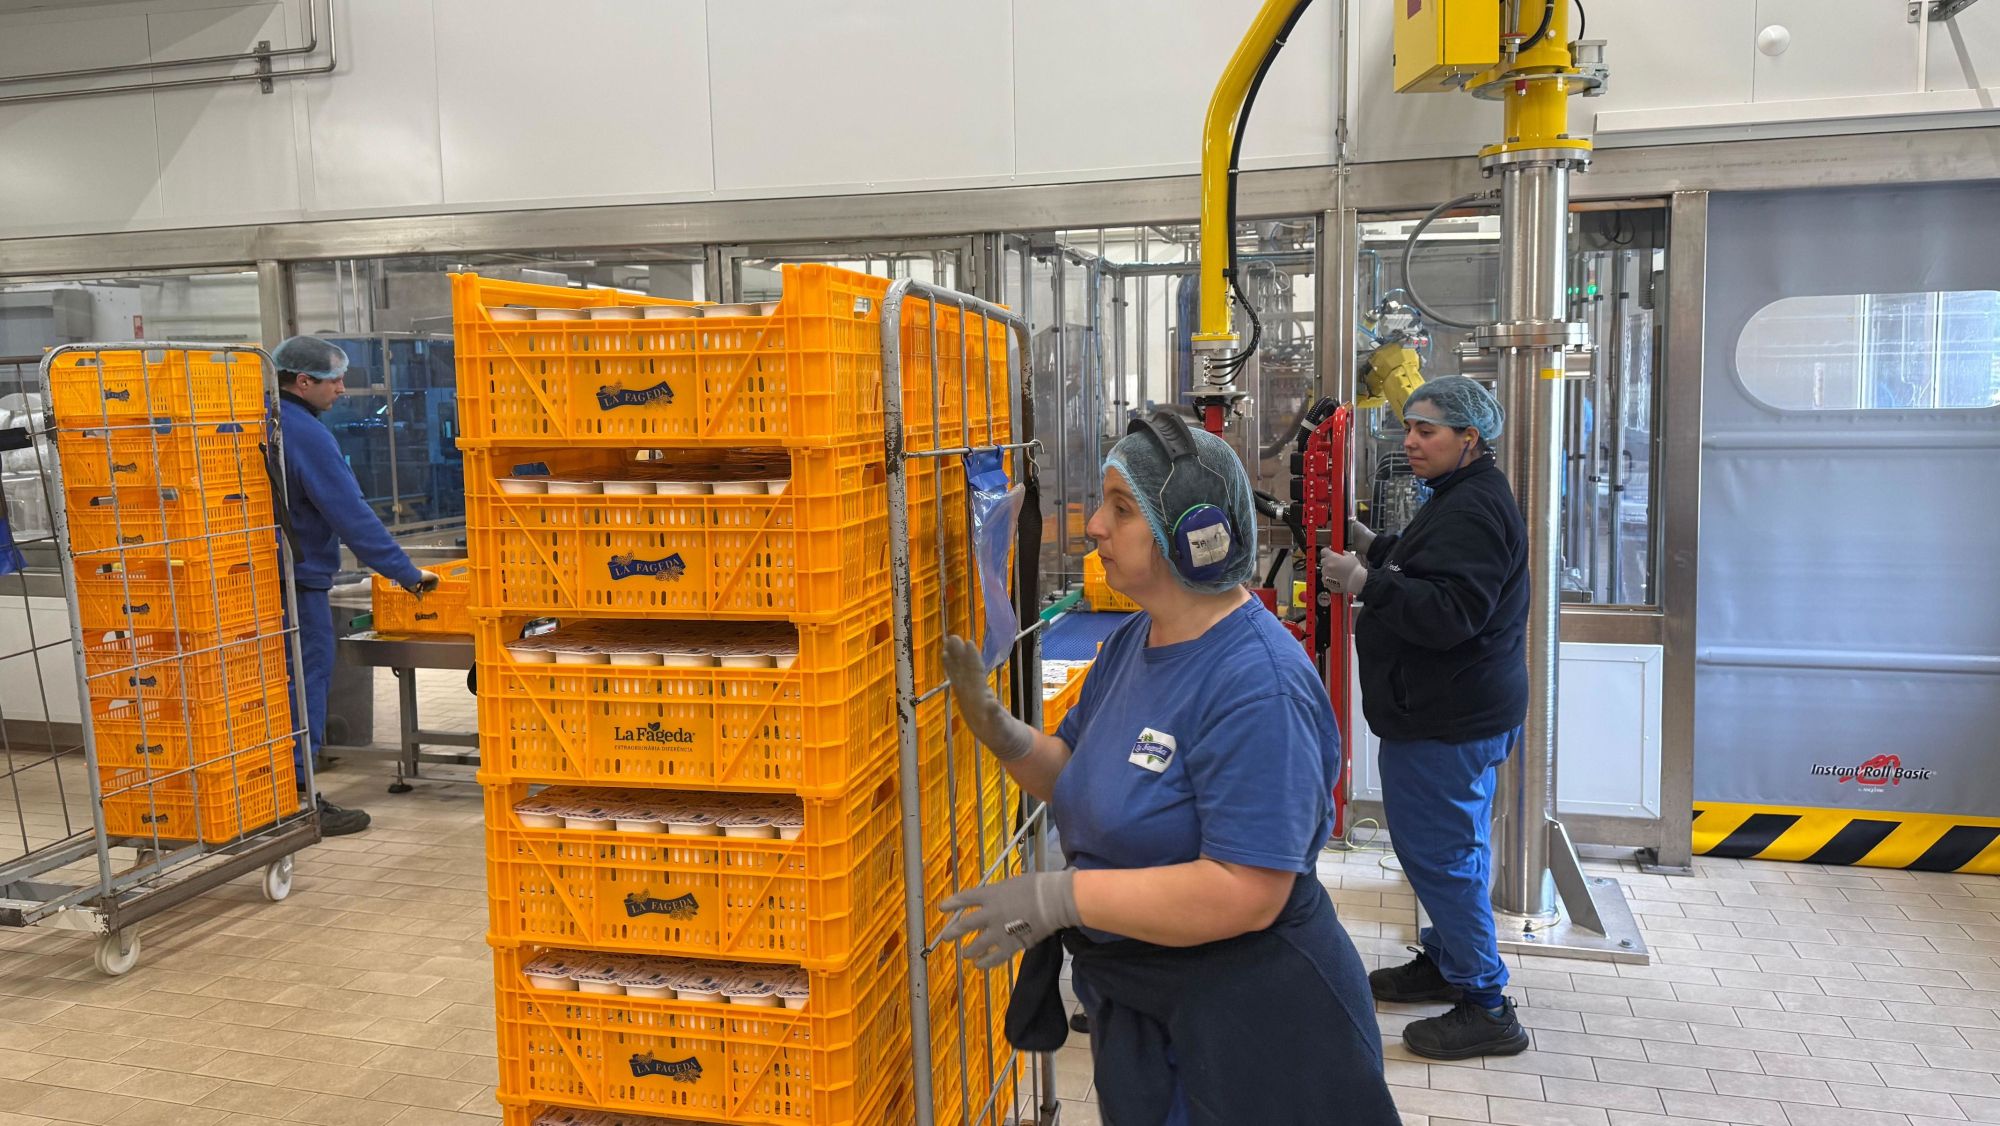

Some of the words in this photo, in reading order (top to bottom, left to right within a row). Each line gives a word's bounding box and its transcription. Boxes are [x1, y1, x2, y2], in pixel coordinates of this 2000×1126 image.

[604, 395, 620, 407] LA
[625, 386, 668, 402] FAGEDA
[615, 566, 631, 576] LA
[636, 558, 680, 573] FAGEDA
[614, 727, 634, 741] La
[636, 727, 693, 745] Fageda
[1811, 763, 1859, 777] Instant
[1864, 764, 1892, 778] Roll
[1894, 766, 1931, 780] Basic
[631, 903, 647, 914] LA
[651, 897, 694, 911] FAGEDA
[636, 1064, 651, 1074] LA
[655, 1061, 697, 1073] FAGEDA
